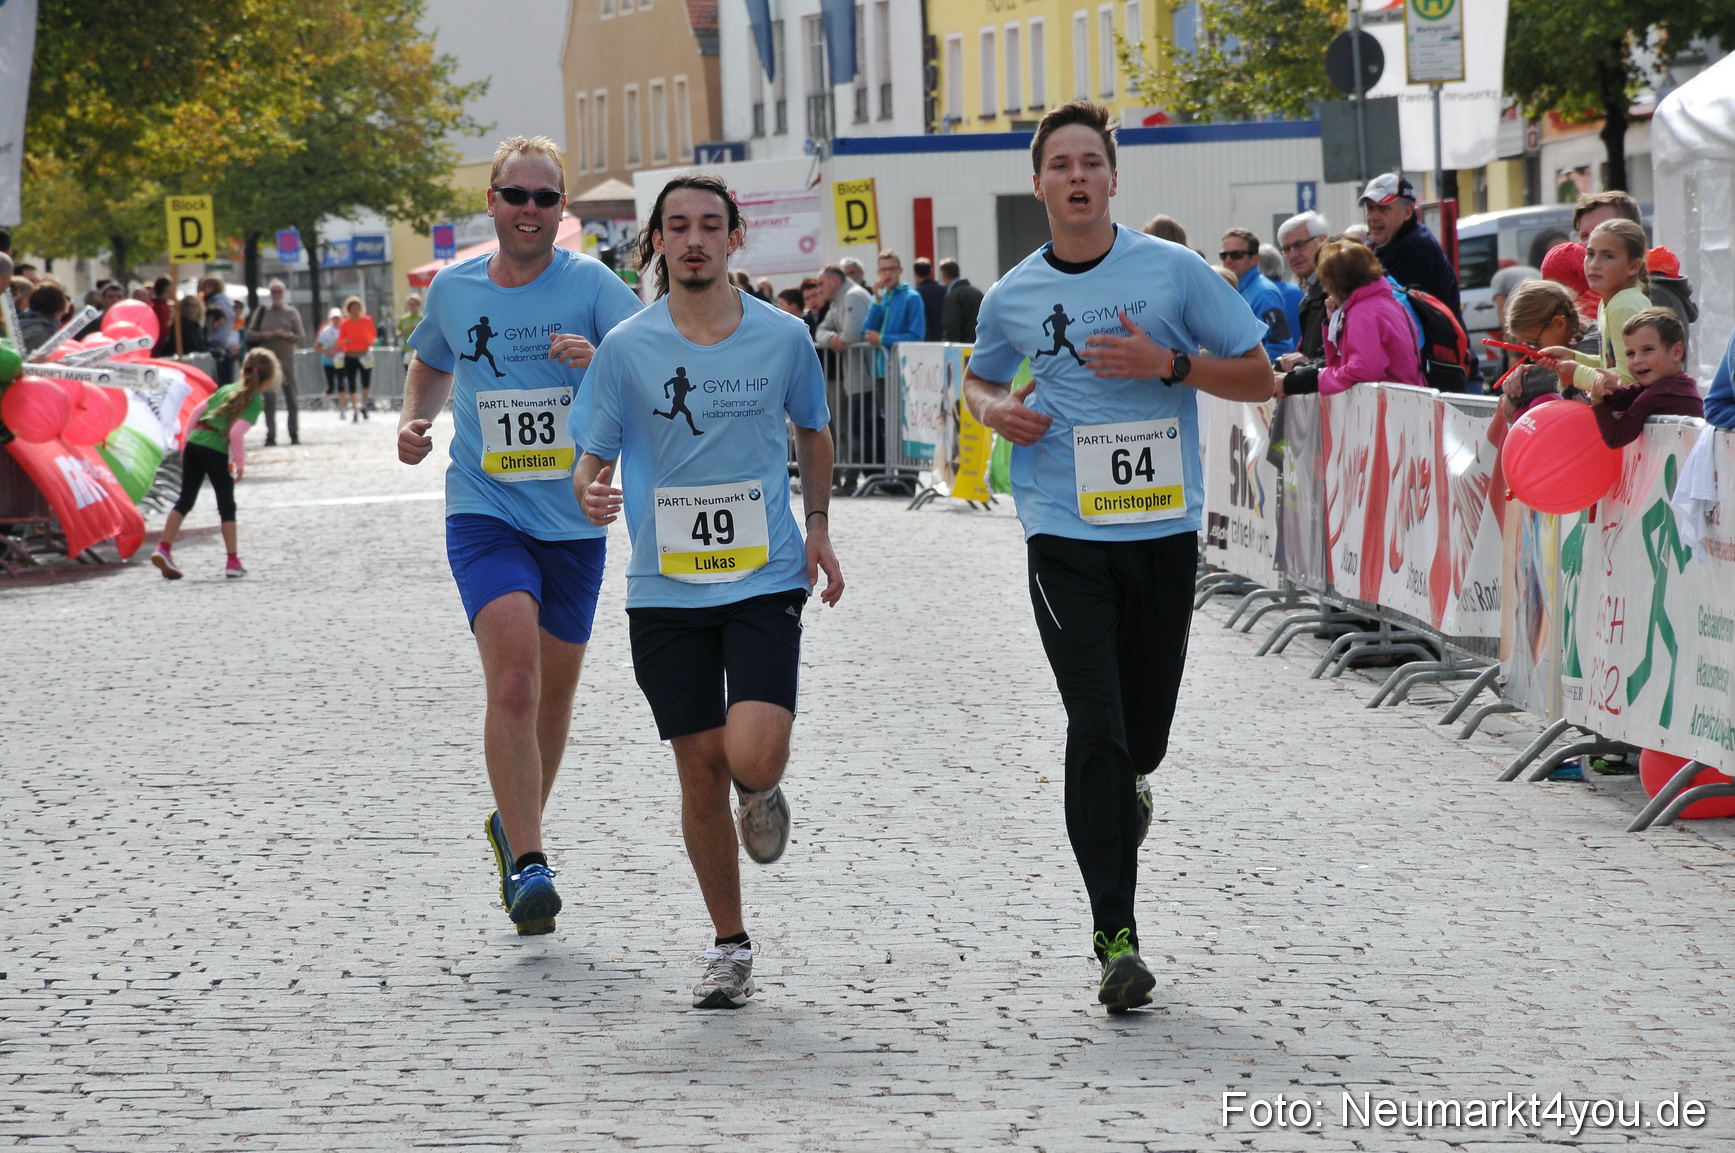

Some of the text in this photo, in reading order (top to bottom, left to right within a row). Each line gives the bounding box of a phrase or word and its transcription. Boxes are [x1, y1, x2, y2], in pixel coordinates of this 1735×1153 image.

[837, 183, 871, 196] Block
[172, 200, 208, 212] Block
[846, 199, 868, 231] D
[181, 217, 203, 248] D
[1082, 300, 1147, 324] GYM HIP
[504, 323, 562, 340] GYM HIP
[503, 351, 563, 362] Halbmarathn
[703, 378, 769, 393] GYM HIP
[479, 398, 557, 410] PARTL Neumarkt
[712, 399, 758, 408] P-Seminar
[702, 408, 765, 419] Halbmarathon
[497, 411, 556, 446] 183
[1077, 431, 1163, 445] PARTL Neumarkt
[501, 455, 556, 470] Christian
[1111, 446, 1155, 485] 64
[657, 493, 745, 507] PARTL Neumarkt
[1094, 493, 1172, 511] Christopher
[691, 509, 735, 546] 49
[695, 556, 736, 571] Lukas
